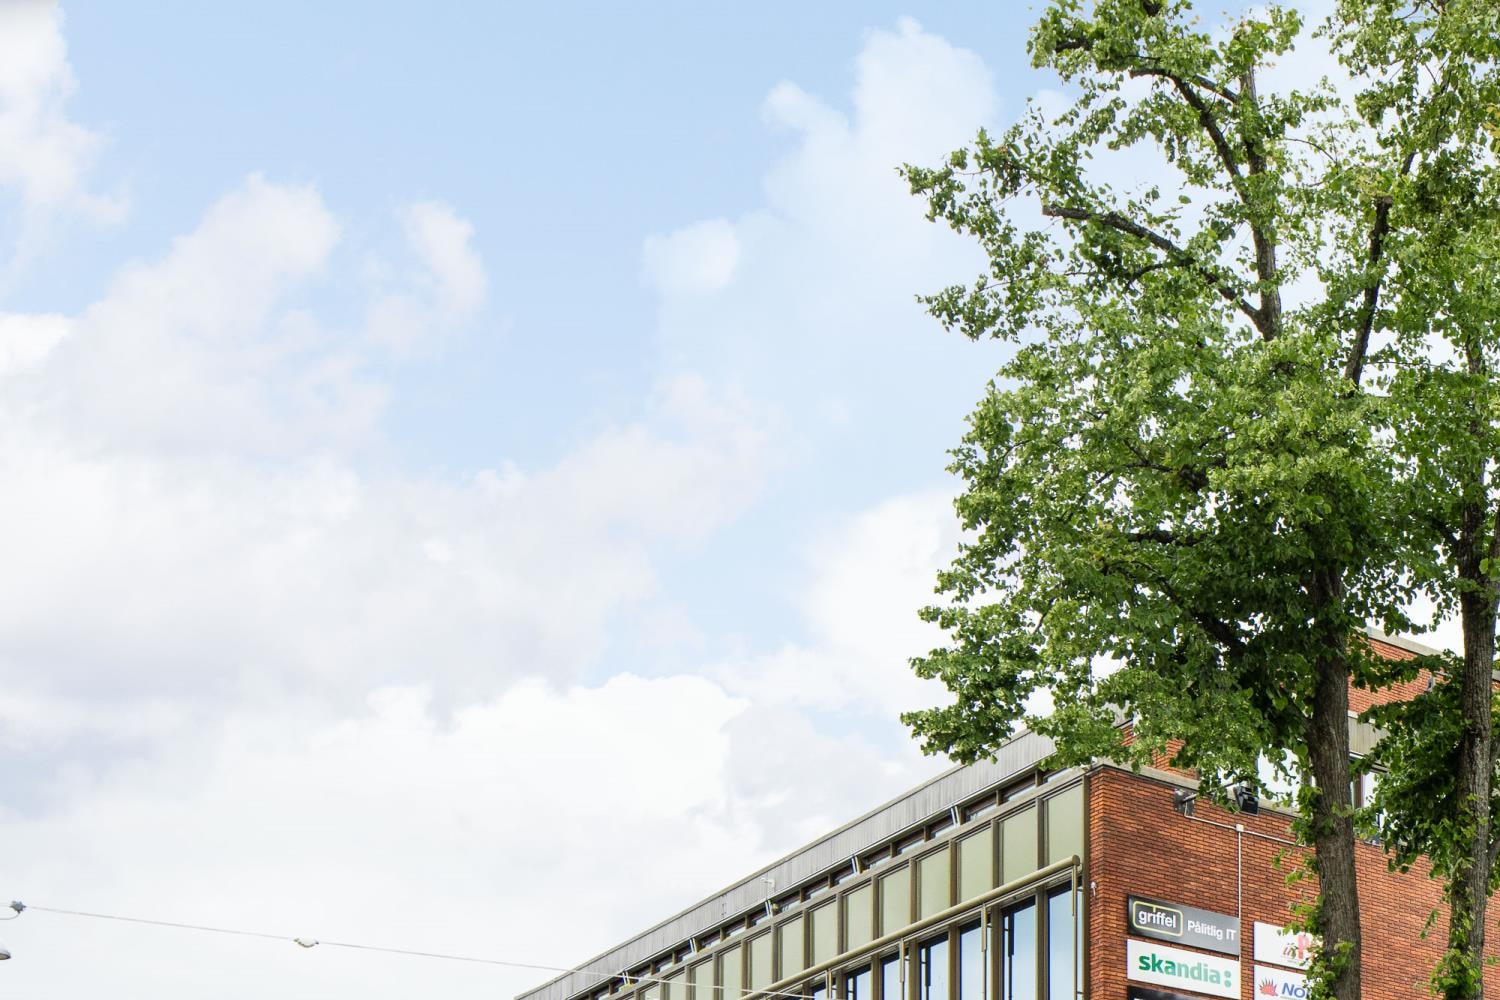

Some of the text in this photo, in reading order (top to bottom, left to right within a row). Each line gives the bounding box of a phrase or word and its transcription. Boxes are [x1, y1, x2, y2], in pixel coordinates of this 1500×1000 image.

[1138, 910, 1237, 941] griffel Pålitlig IT
